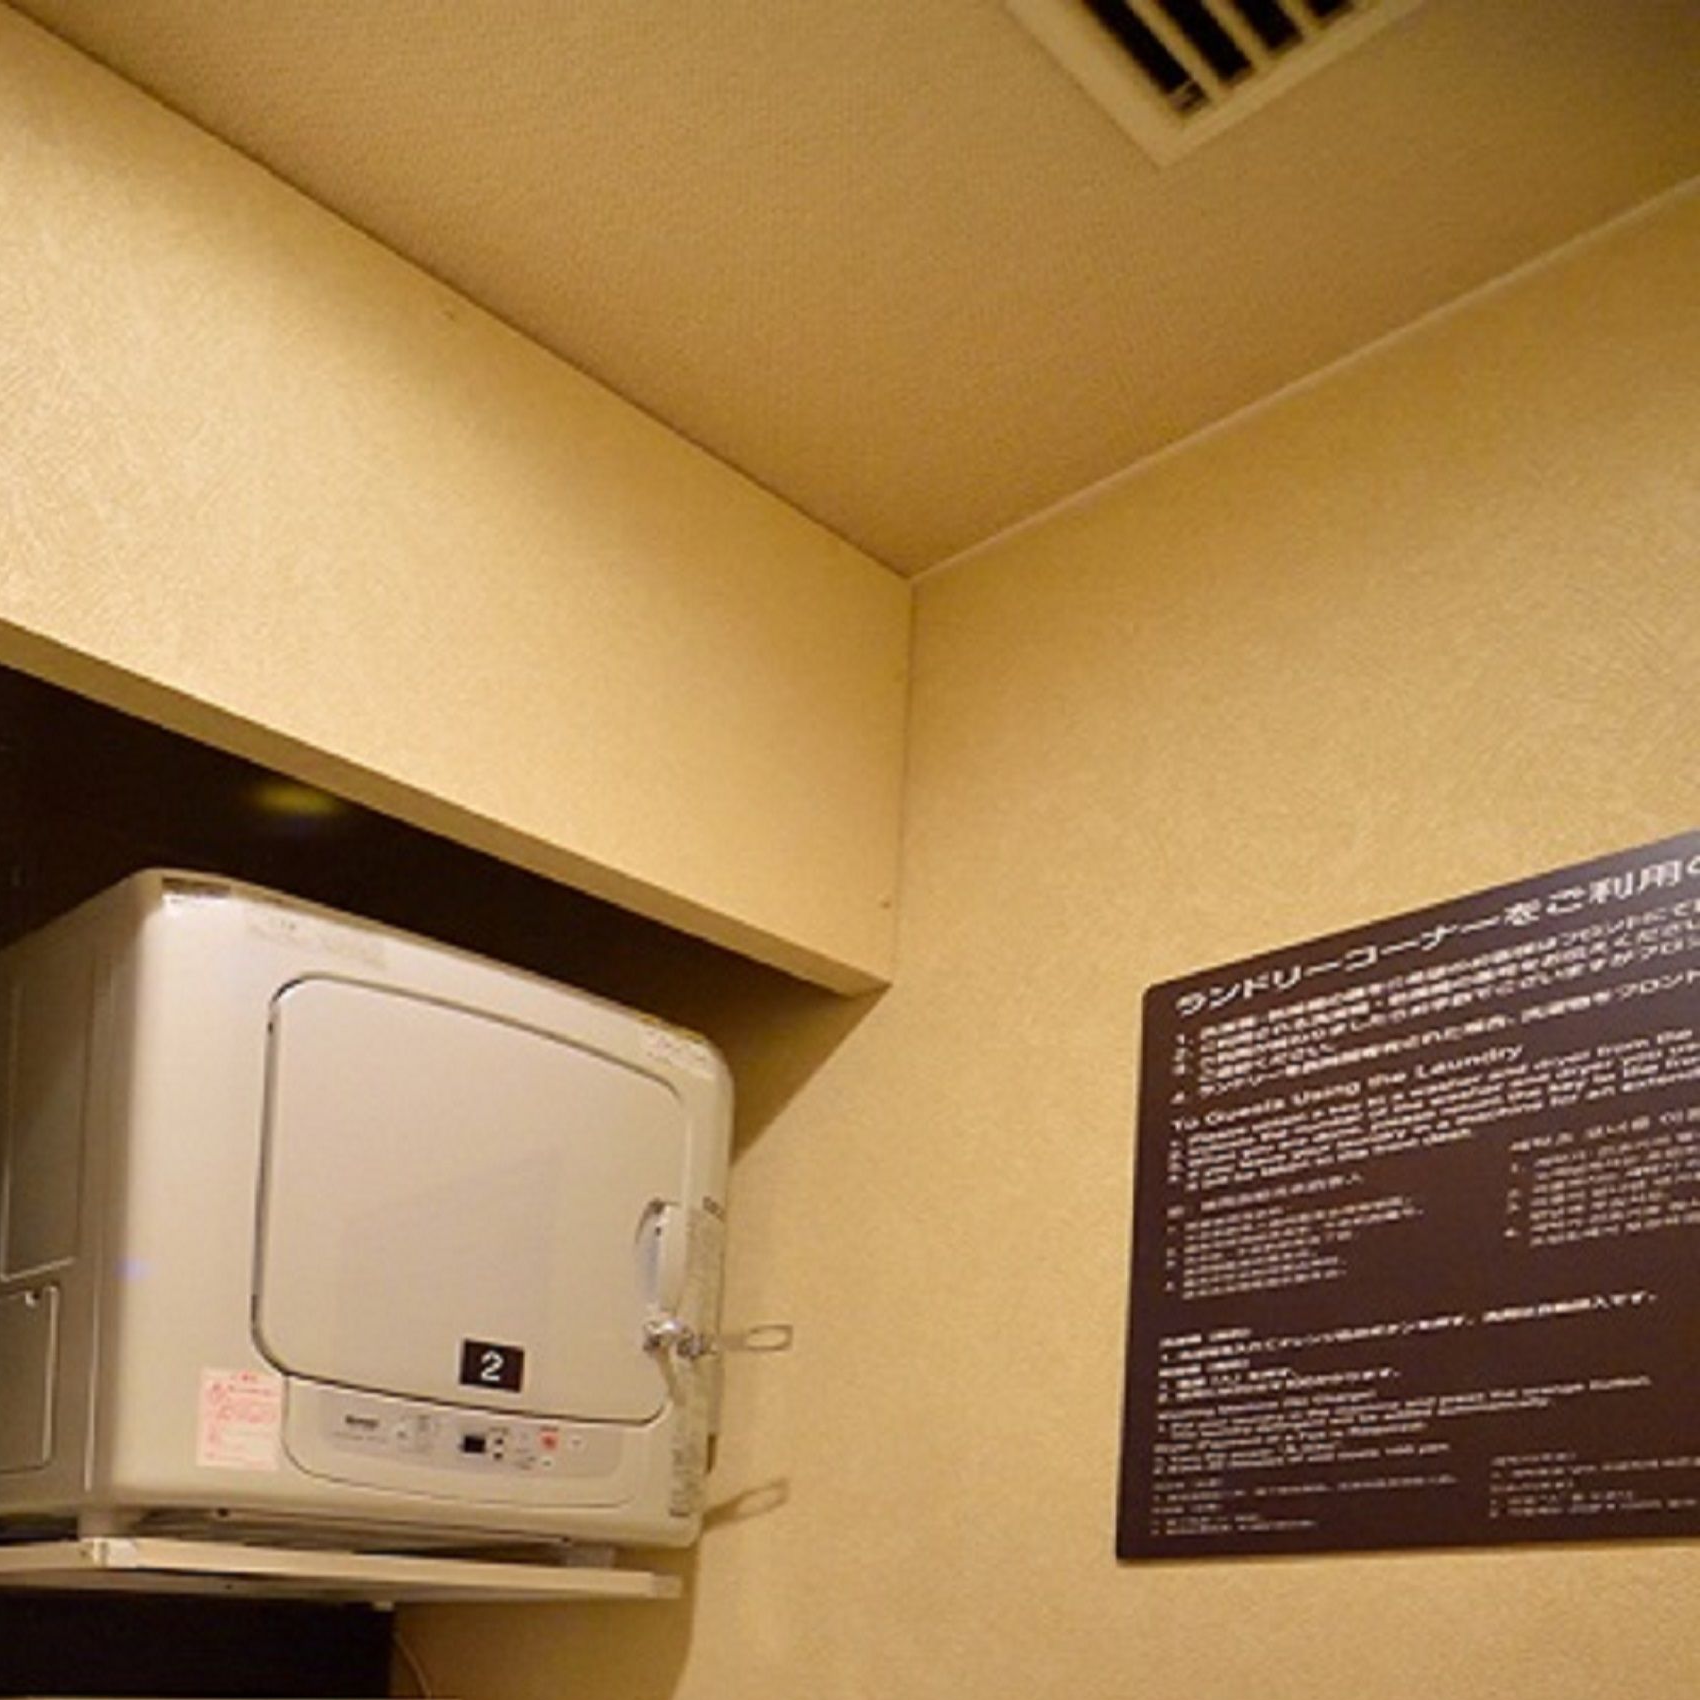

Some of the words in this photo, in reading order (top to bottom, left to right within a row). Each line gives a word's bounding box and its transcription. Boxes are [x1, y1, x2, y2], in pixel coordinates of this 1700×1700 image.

[1292, 1081, 1361, 1106] Using
[1367, 1071, 1407, 1087] the
[1415, 1044, 1523, 1079] Laundry
[481, 1349, 505, 1382] 2
